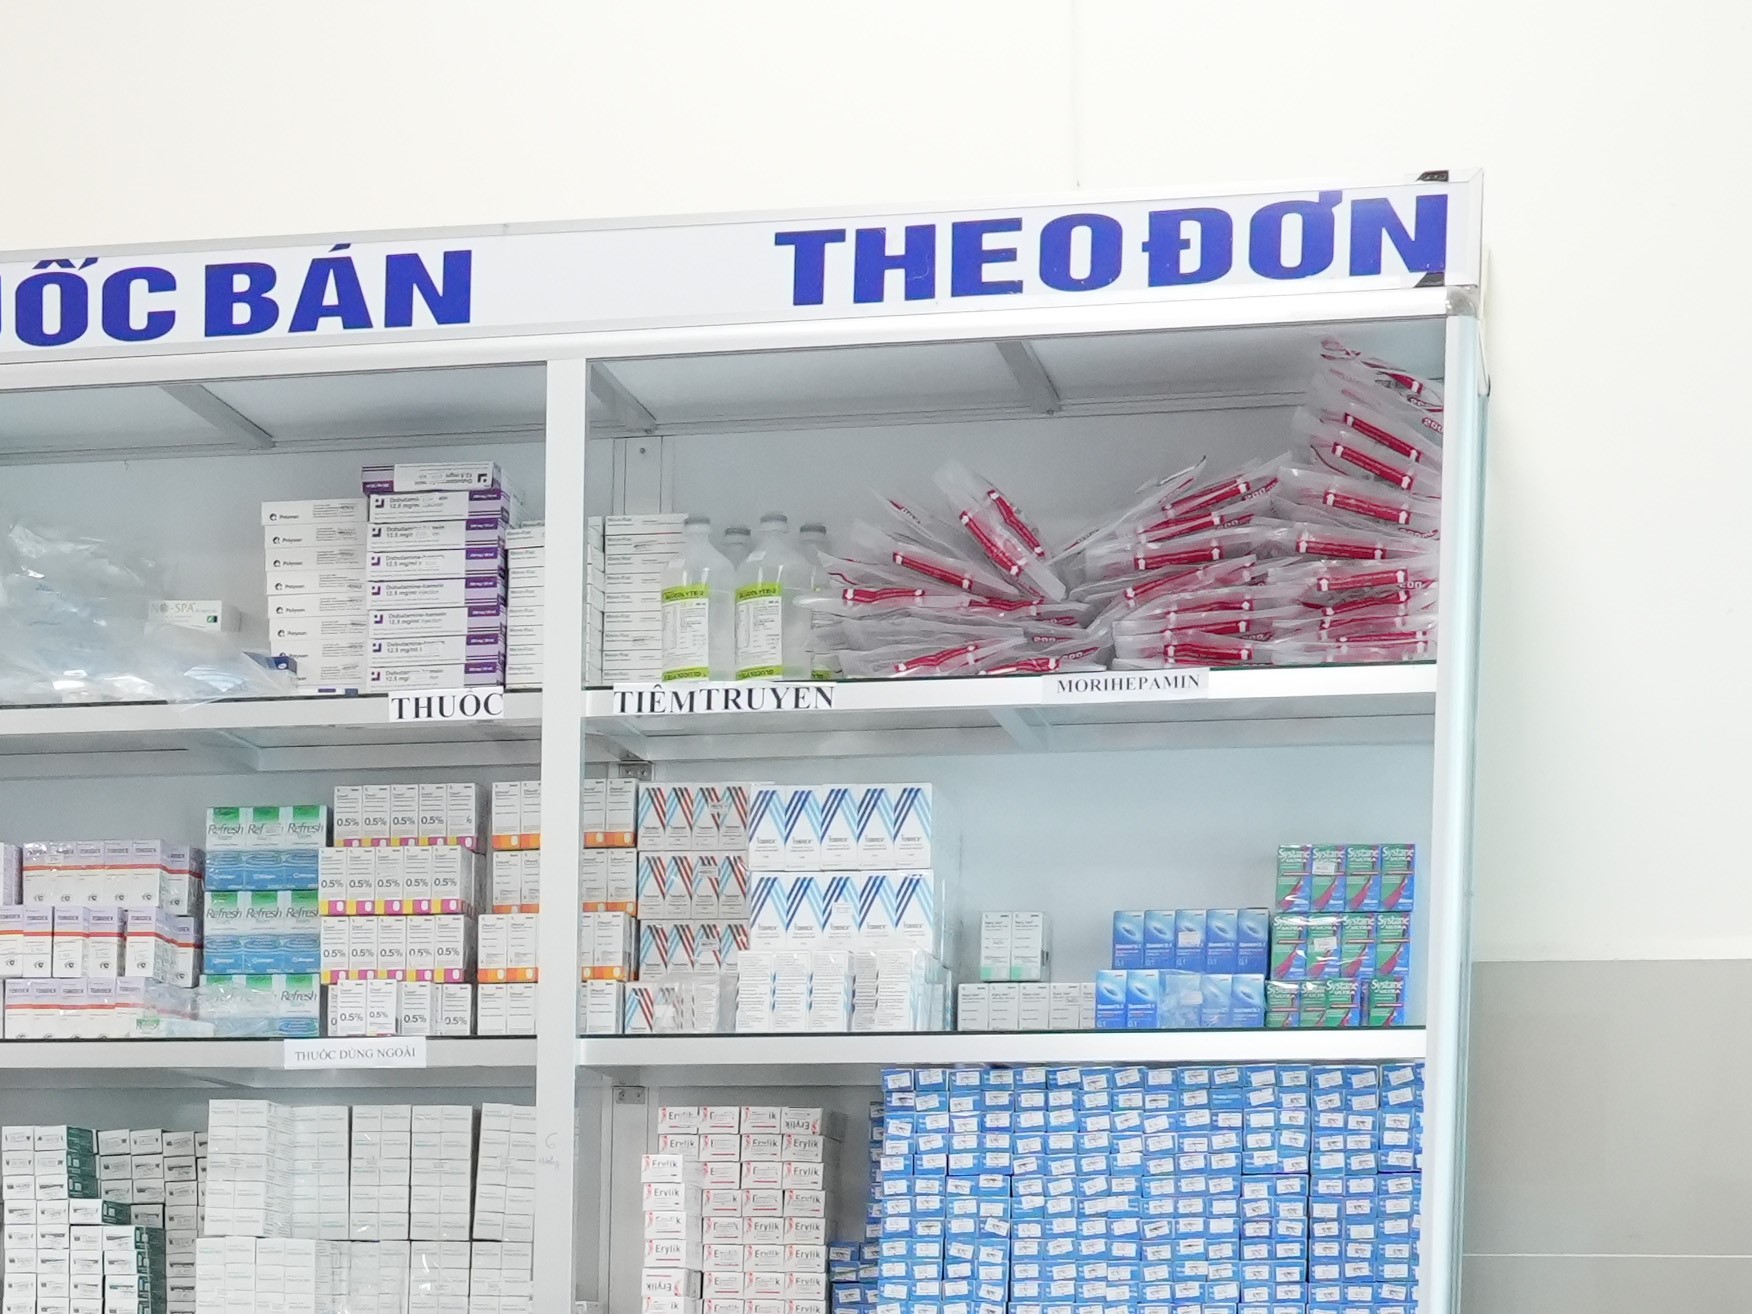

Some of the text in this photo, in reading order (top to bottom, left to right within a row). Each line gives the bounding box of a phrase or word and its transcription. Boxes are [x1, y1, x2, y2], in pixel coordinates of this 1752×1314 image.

[204, 243, 472, 337] BÁN
[1056, 674, 1201, 695] MORIHEPAMIN
[337, 818, 359, 827] 0.5%
[421, 815, 444, 825] 0.5%
[208, 823, 244, 836] Refresh
[288, 822, 324, 836] Refresh
[321, 878, 343, 889] 0.5%
[434, 877, 457, 888] 0.5%
[206, 907, 242, 920] Refresh
[246, 907, 282, 920] Refresh
[281, 990, 317, 1003] Refresh
[295, 1046, 416, 1062] THUỐC DÙNG NGOÀI
[793, 1139, 819, 1150] Erylik
[753, 1222, 779, 1233] Erylik
[655, 1244, 681, 1255] Erylik
[795, 1250, 821, 1260] Erylik
